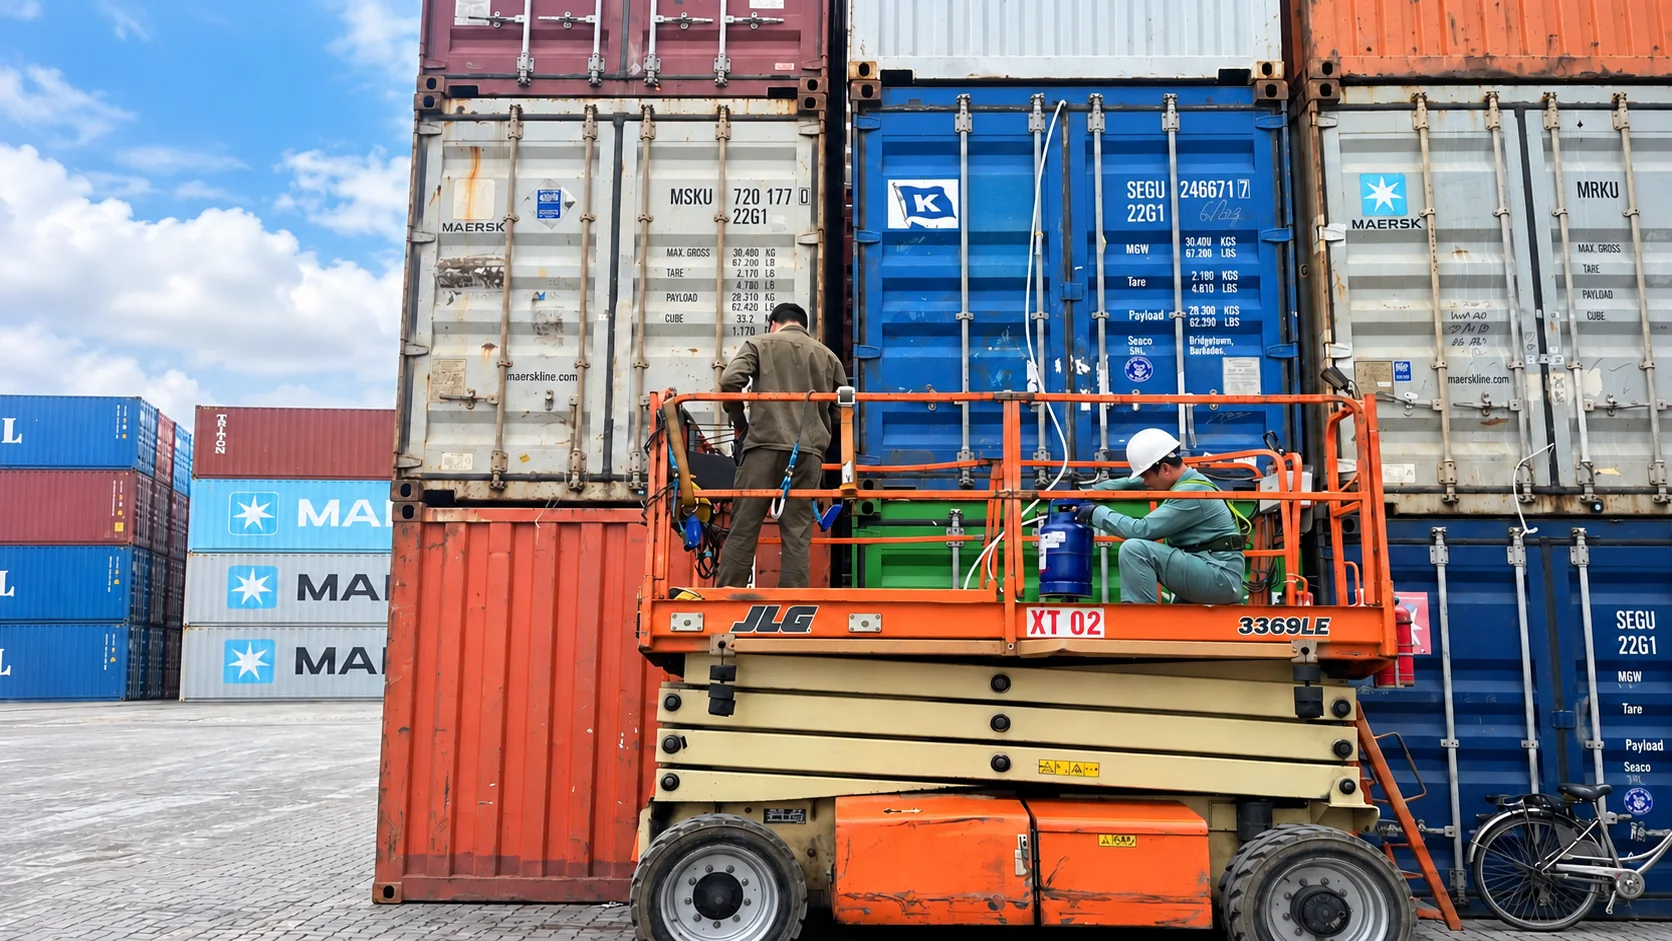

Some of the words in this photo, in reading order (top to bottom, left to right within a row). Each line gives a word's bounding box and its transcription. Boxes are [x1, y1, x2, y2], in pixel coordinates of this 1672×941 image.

[1127, 180, 1165, 199] SEGU
[1180, 180, 1234, 198] 246671
[1238, 179, 1249, 198] 7
[1577, 181, 1619, 199] MRKU
[670, 188, 713, 205] MSKU
[733, 188, 760, 205] 720
[767, 188, 792, 205] 177
[913, 194, 942, 212] K
[733, 208, 767, 225] 22G1
[1127, 203, 1164, 222] 22G1
[442, 222, 505, 232] MAERSK
[1351, 218, 1422, 230] MAERSK
[666, 248, 685, 257] MAX.
[686, 248, 711, 257] GROSS
[765, 248, 776, 257] KG
[1126, 244, 1149, 254] MGW
[1598, 244, 1621, 253] GROSS
[666, 268, 684, 278] TARE
[1582, 264, 1600, 274] TARE
[1127, 276, 1147, 287] Tare
[1222, 283, 1238, 293] LBS
[666, 293, 698, 302] PAYLOAD
[1582, 289, 1614, 300] PAYLOAD
[665, 314, 684, 323] CUBE
[736, 314, 754, 324] 33.2
[1128, 310, 1164, 322] Payload
[1587, 311, 1605, 321] CUBE
[1224, 317, 1240, 327] LBS
[733, 326, 756, 336] 1.170
[1128, 335, 1153, 346] Seaco
[506, 371, 577, 382] maerskline.com
[1448, 374, 1510, 384] maerskline.com
[214, 413, 228, 454] TRITON
[297, 498, 394, 528] MA
[297, 573, 390, 601] MA
[729, 605, 819, 634] JLG
[1030, 609, 1060, 635] XT
[1070, 610, 1101, 636] 02
[1616, 610, 1656, 630] SEGU
[1237, 616, 1331, 636] 3369LE
[1618, 635, 1657, 655] 22G1
[294, 646, 386, 675] MA
[1617, 671, 1642, 682] MGW
[1622, 702, 1643, 714] Tare
[1625, 739, 1664, 753] Payload
[1624, 761, 1651, 772] Seaco
